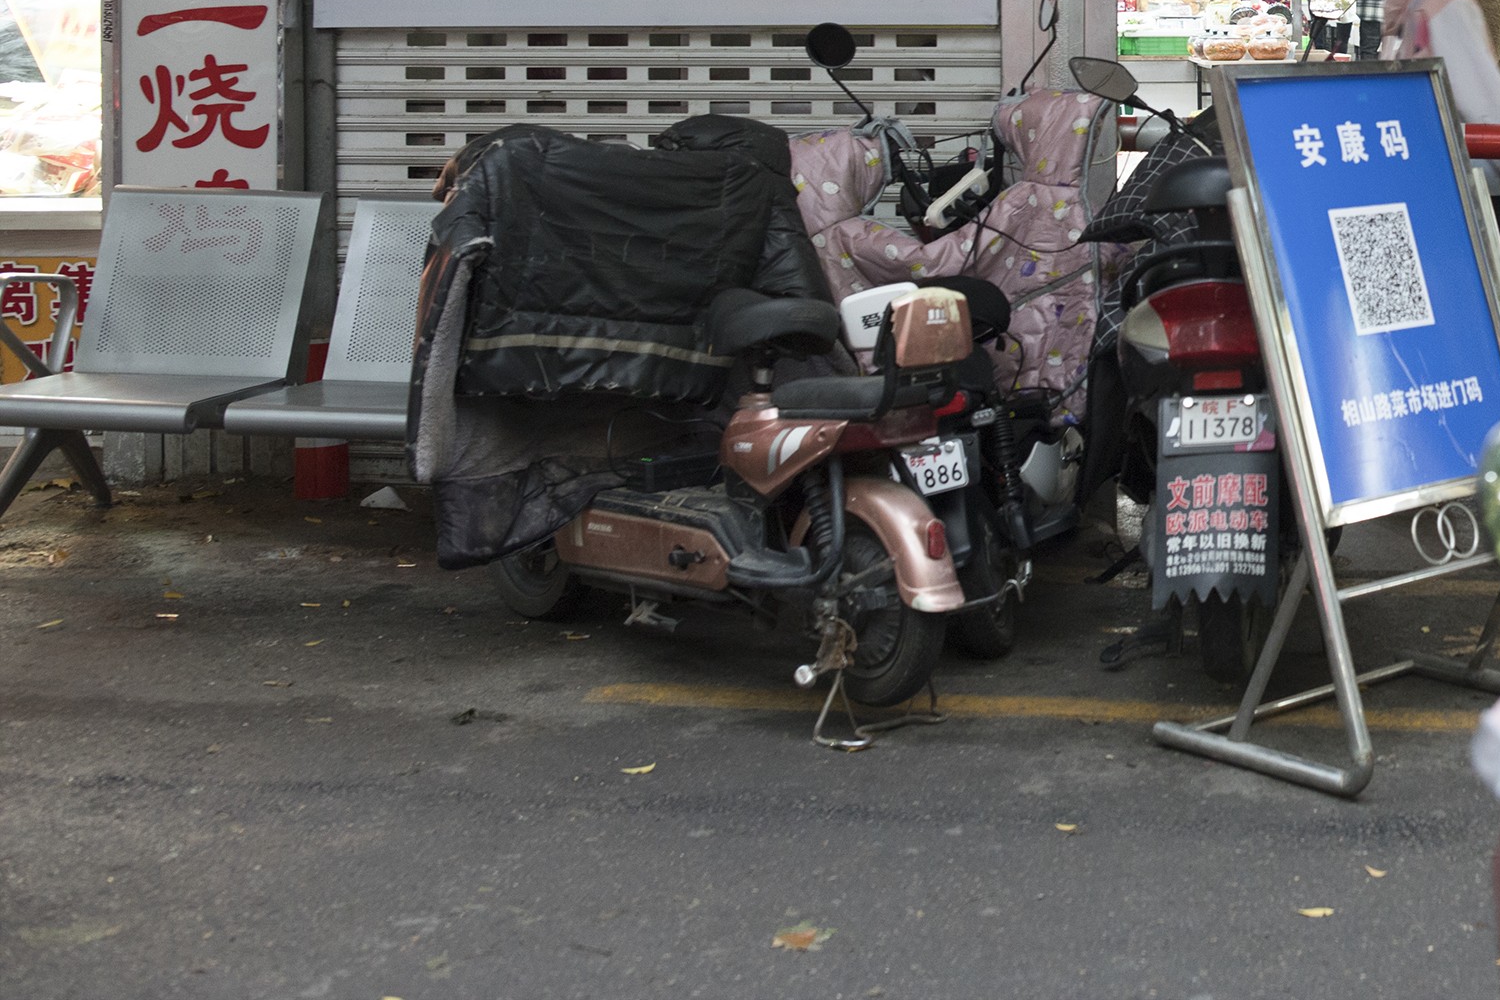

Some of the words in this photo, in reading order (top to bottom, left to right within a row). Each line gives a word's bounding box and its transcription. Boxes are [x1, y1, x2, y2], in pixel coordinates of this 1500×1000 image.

[1293, 119, 1410, 169] 安康码
[1341, 376, 1484, 428] 相山路菜市场进门码
[1188, 416, 1254, 440] 11378
[913, 462, 963, 488] 886
[1167, 473, 1269, 510] 文前摩配
[1166, 510, 1269, 535] 欧派电动车
